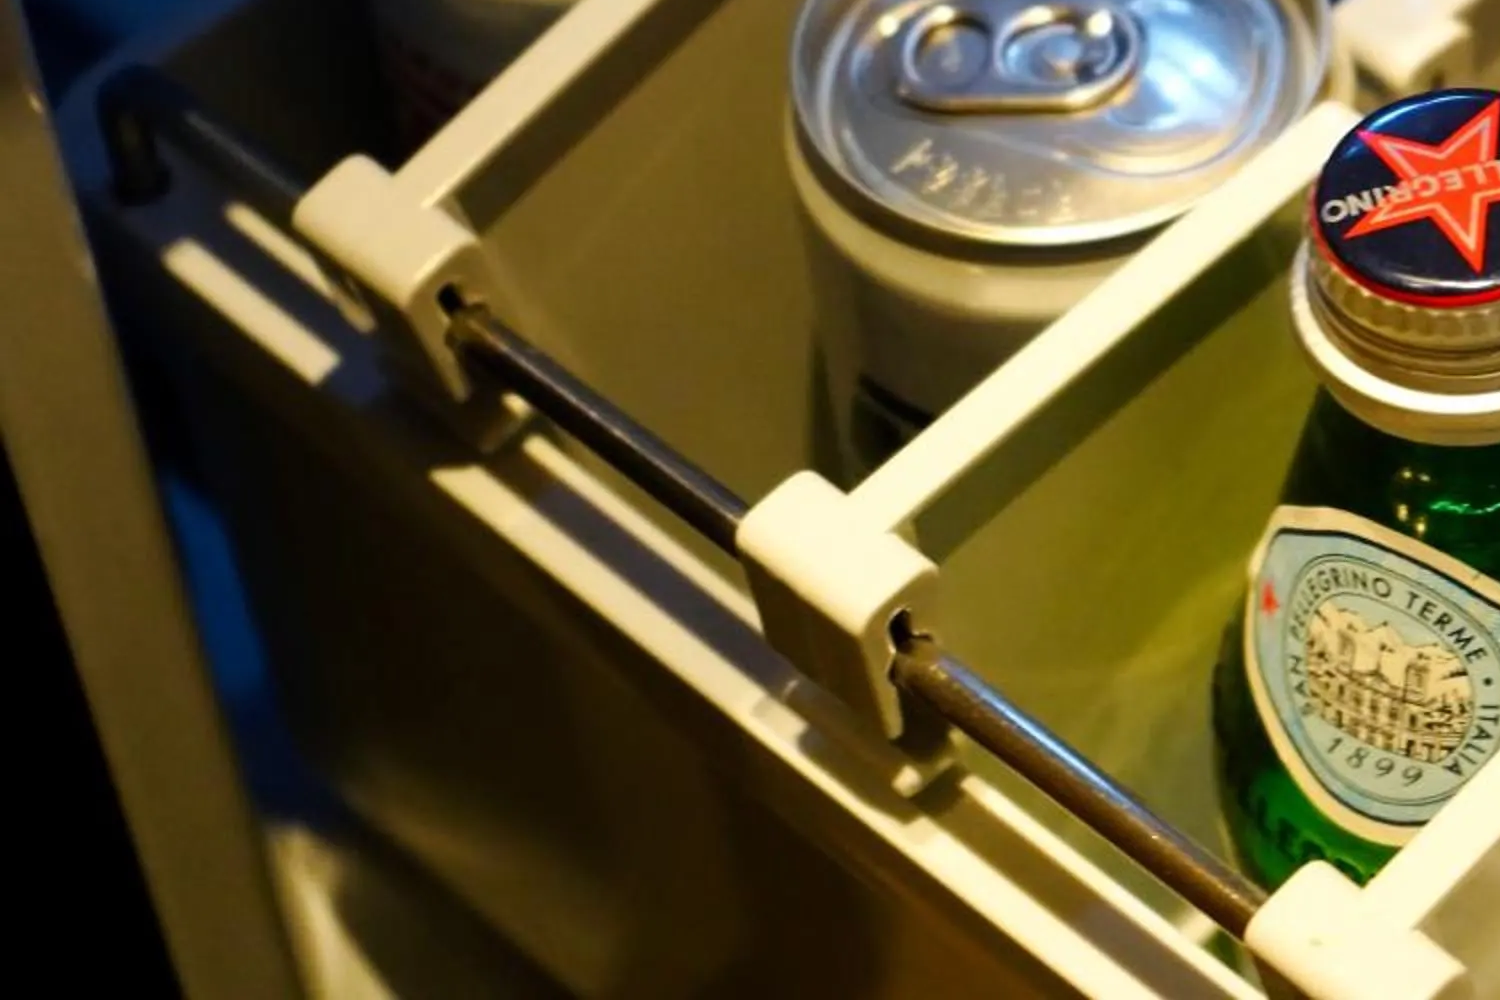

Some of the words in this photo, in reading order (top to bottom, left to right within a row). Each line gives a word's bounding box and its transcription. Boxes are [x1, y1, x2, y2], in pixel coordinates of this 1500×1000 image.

[1403, 591, 1487, 665] TERME
[1327, 737, 1424, 788] 1899
[1442, 704, 1500, 778] ITALIA
